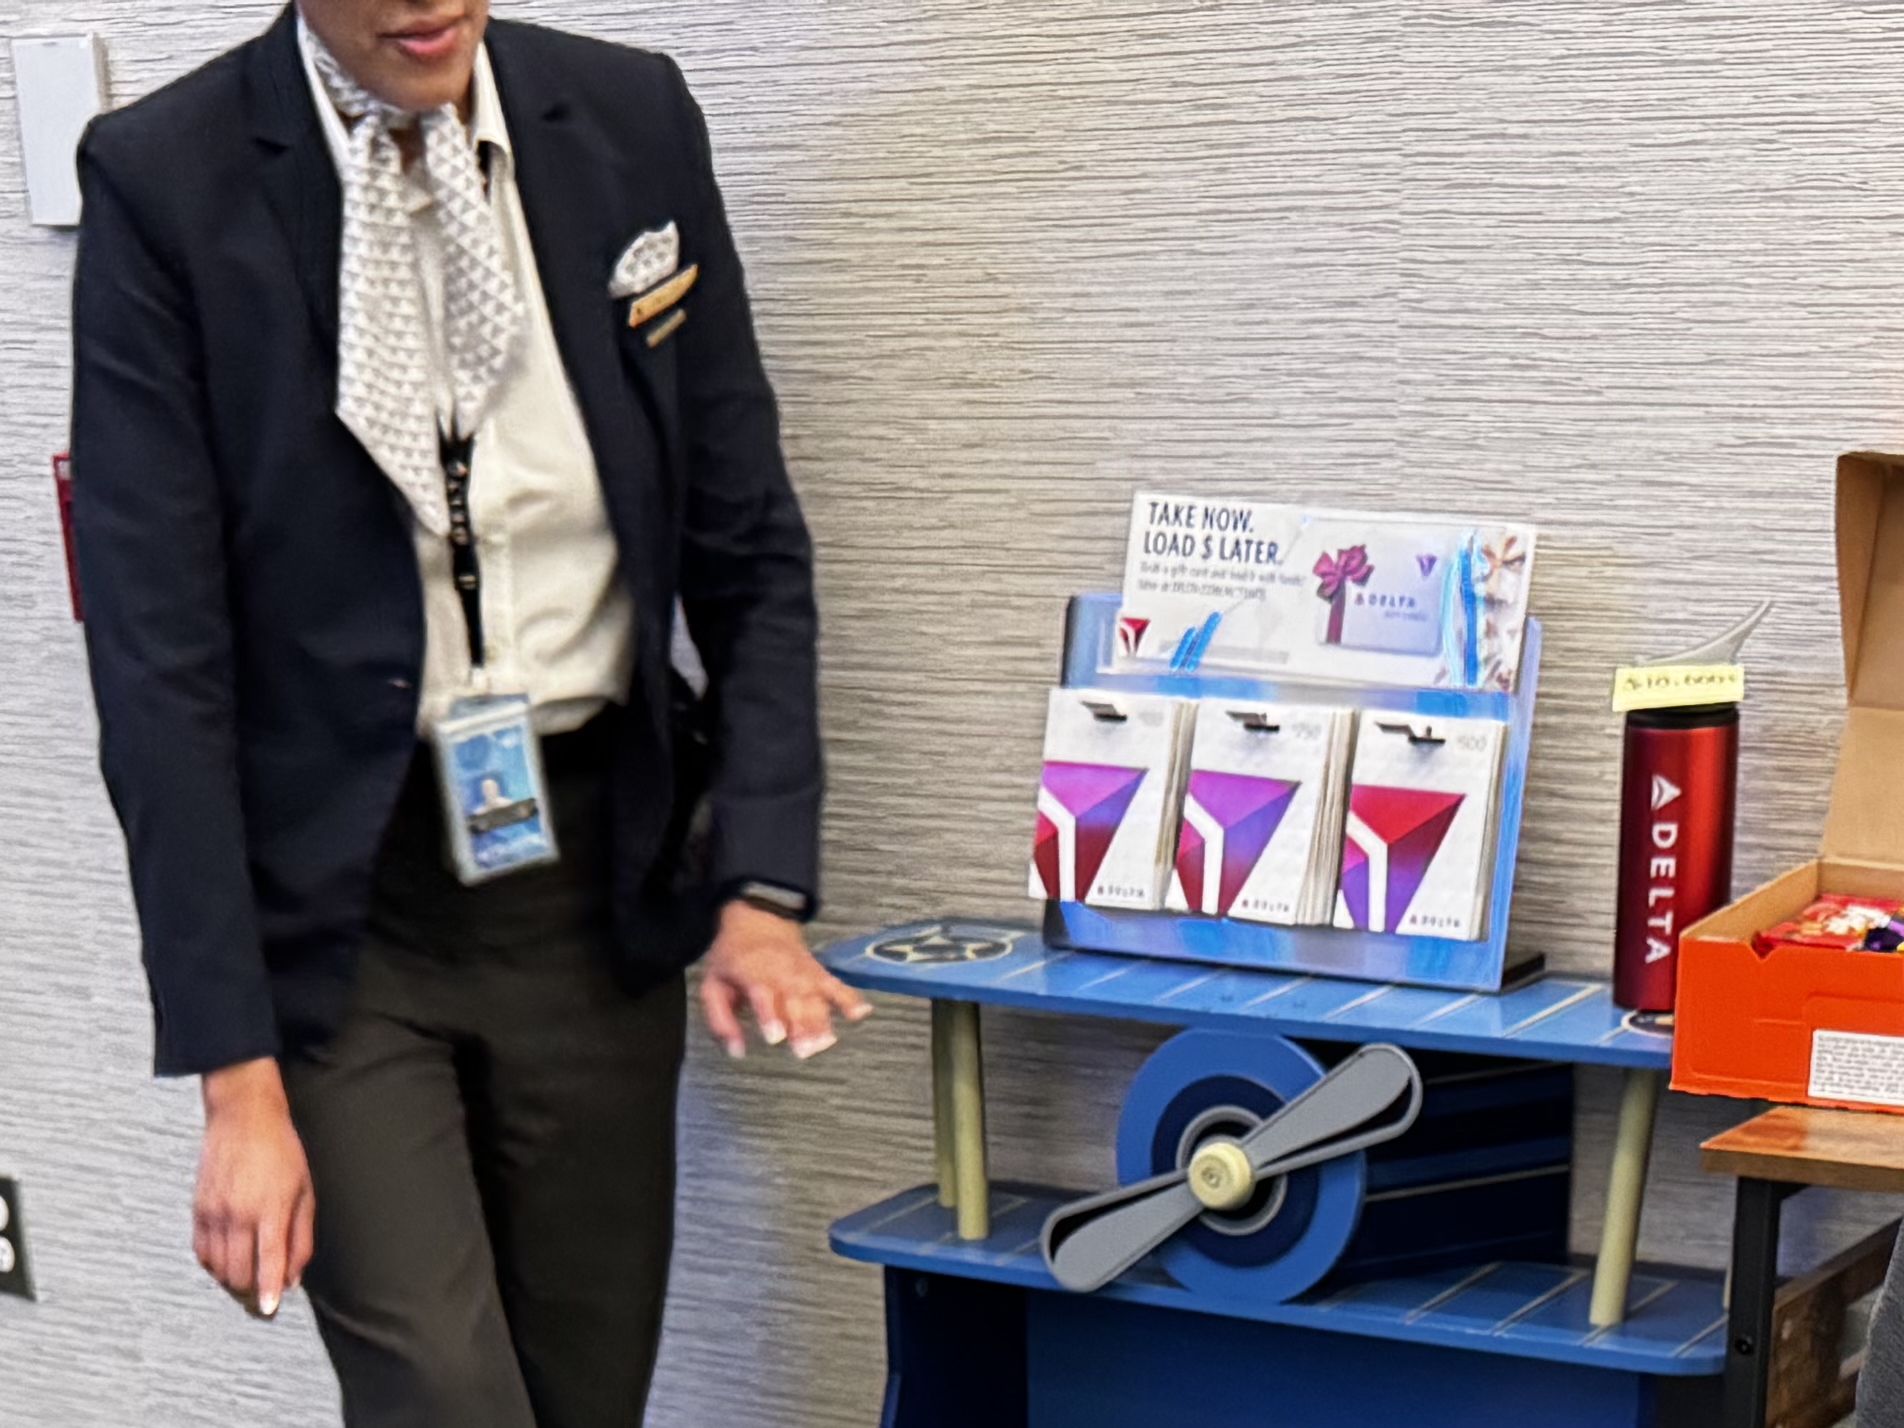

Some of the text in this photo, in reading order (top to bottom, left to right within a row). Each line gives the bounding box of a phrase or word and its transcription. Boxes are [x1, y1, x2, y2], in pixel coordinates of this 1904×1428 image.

[1149, 501, 1254, 533] TAKE NOW.
[1143, 530, 1284, 566] LOAD $ LATER.
[1645, 822, 1678, 964] DELTA
